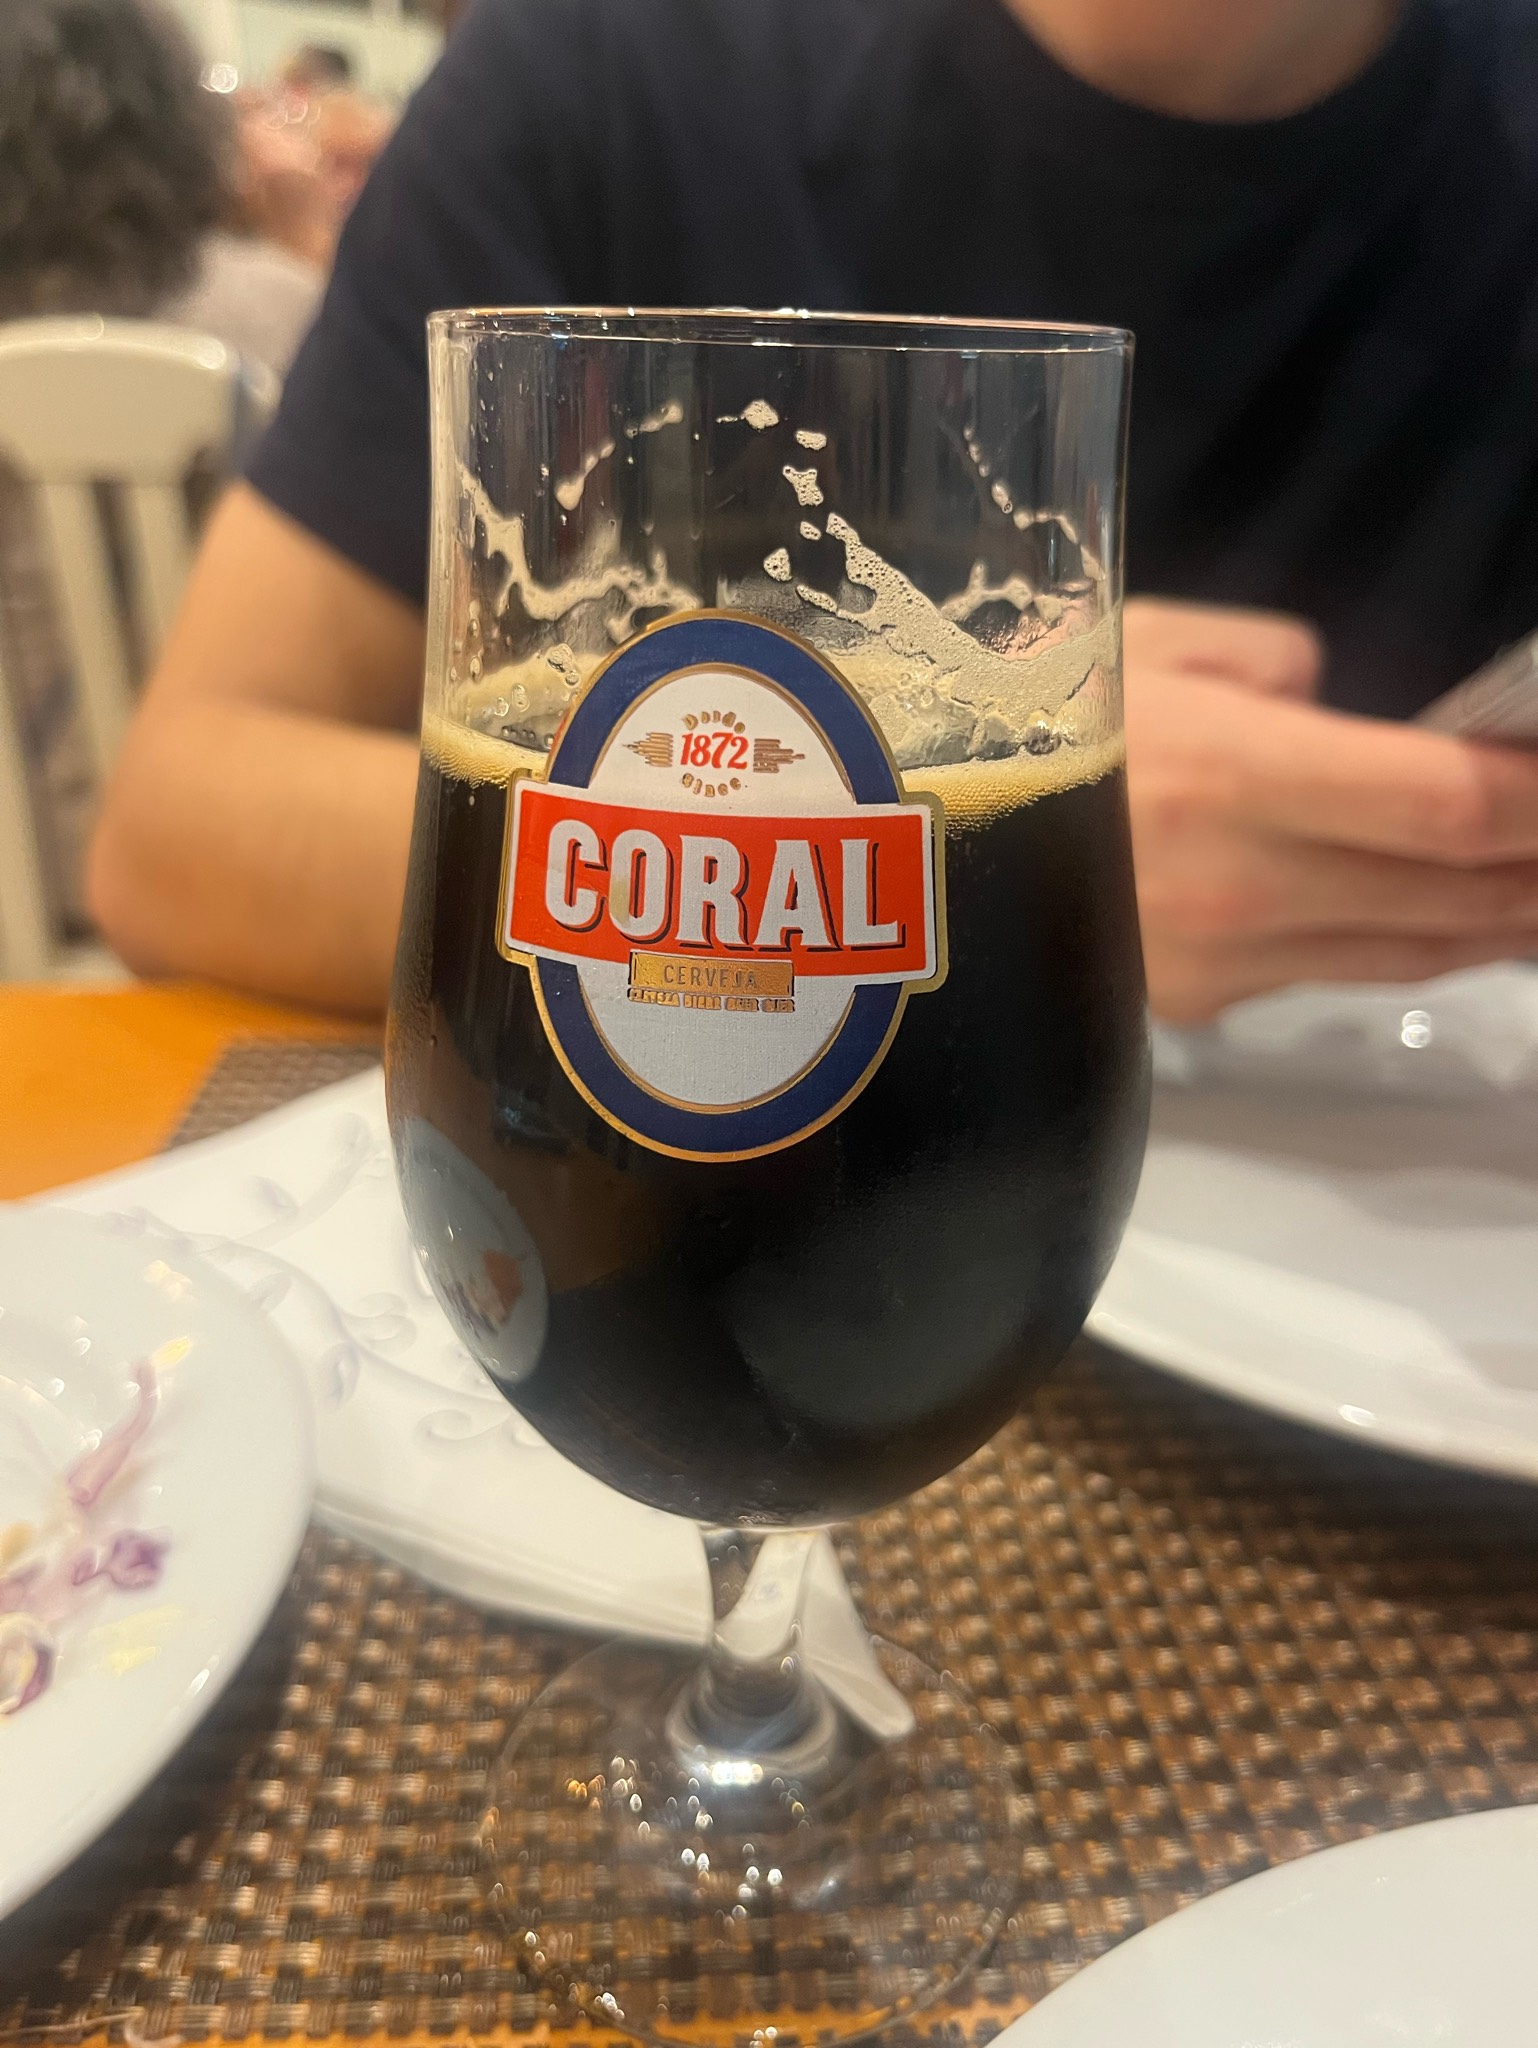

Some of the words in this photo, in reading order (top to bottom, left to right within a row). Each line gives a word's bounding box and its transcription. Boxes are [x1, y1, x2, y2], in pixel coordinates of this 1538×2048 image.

[680, 732, 749, 769] 1872
[545, 819, 907, 952] CORAL
[664, 964, 758, 989] CERVEJA
